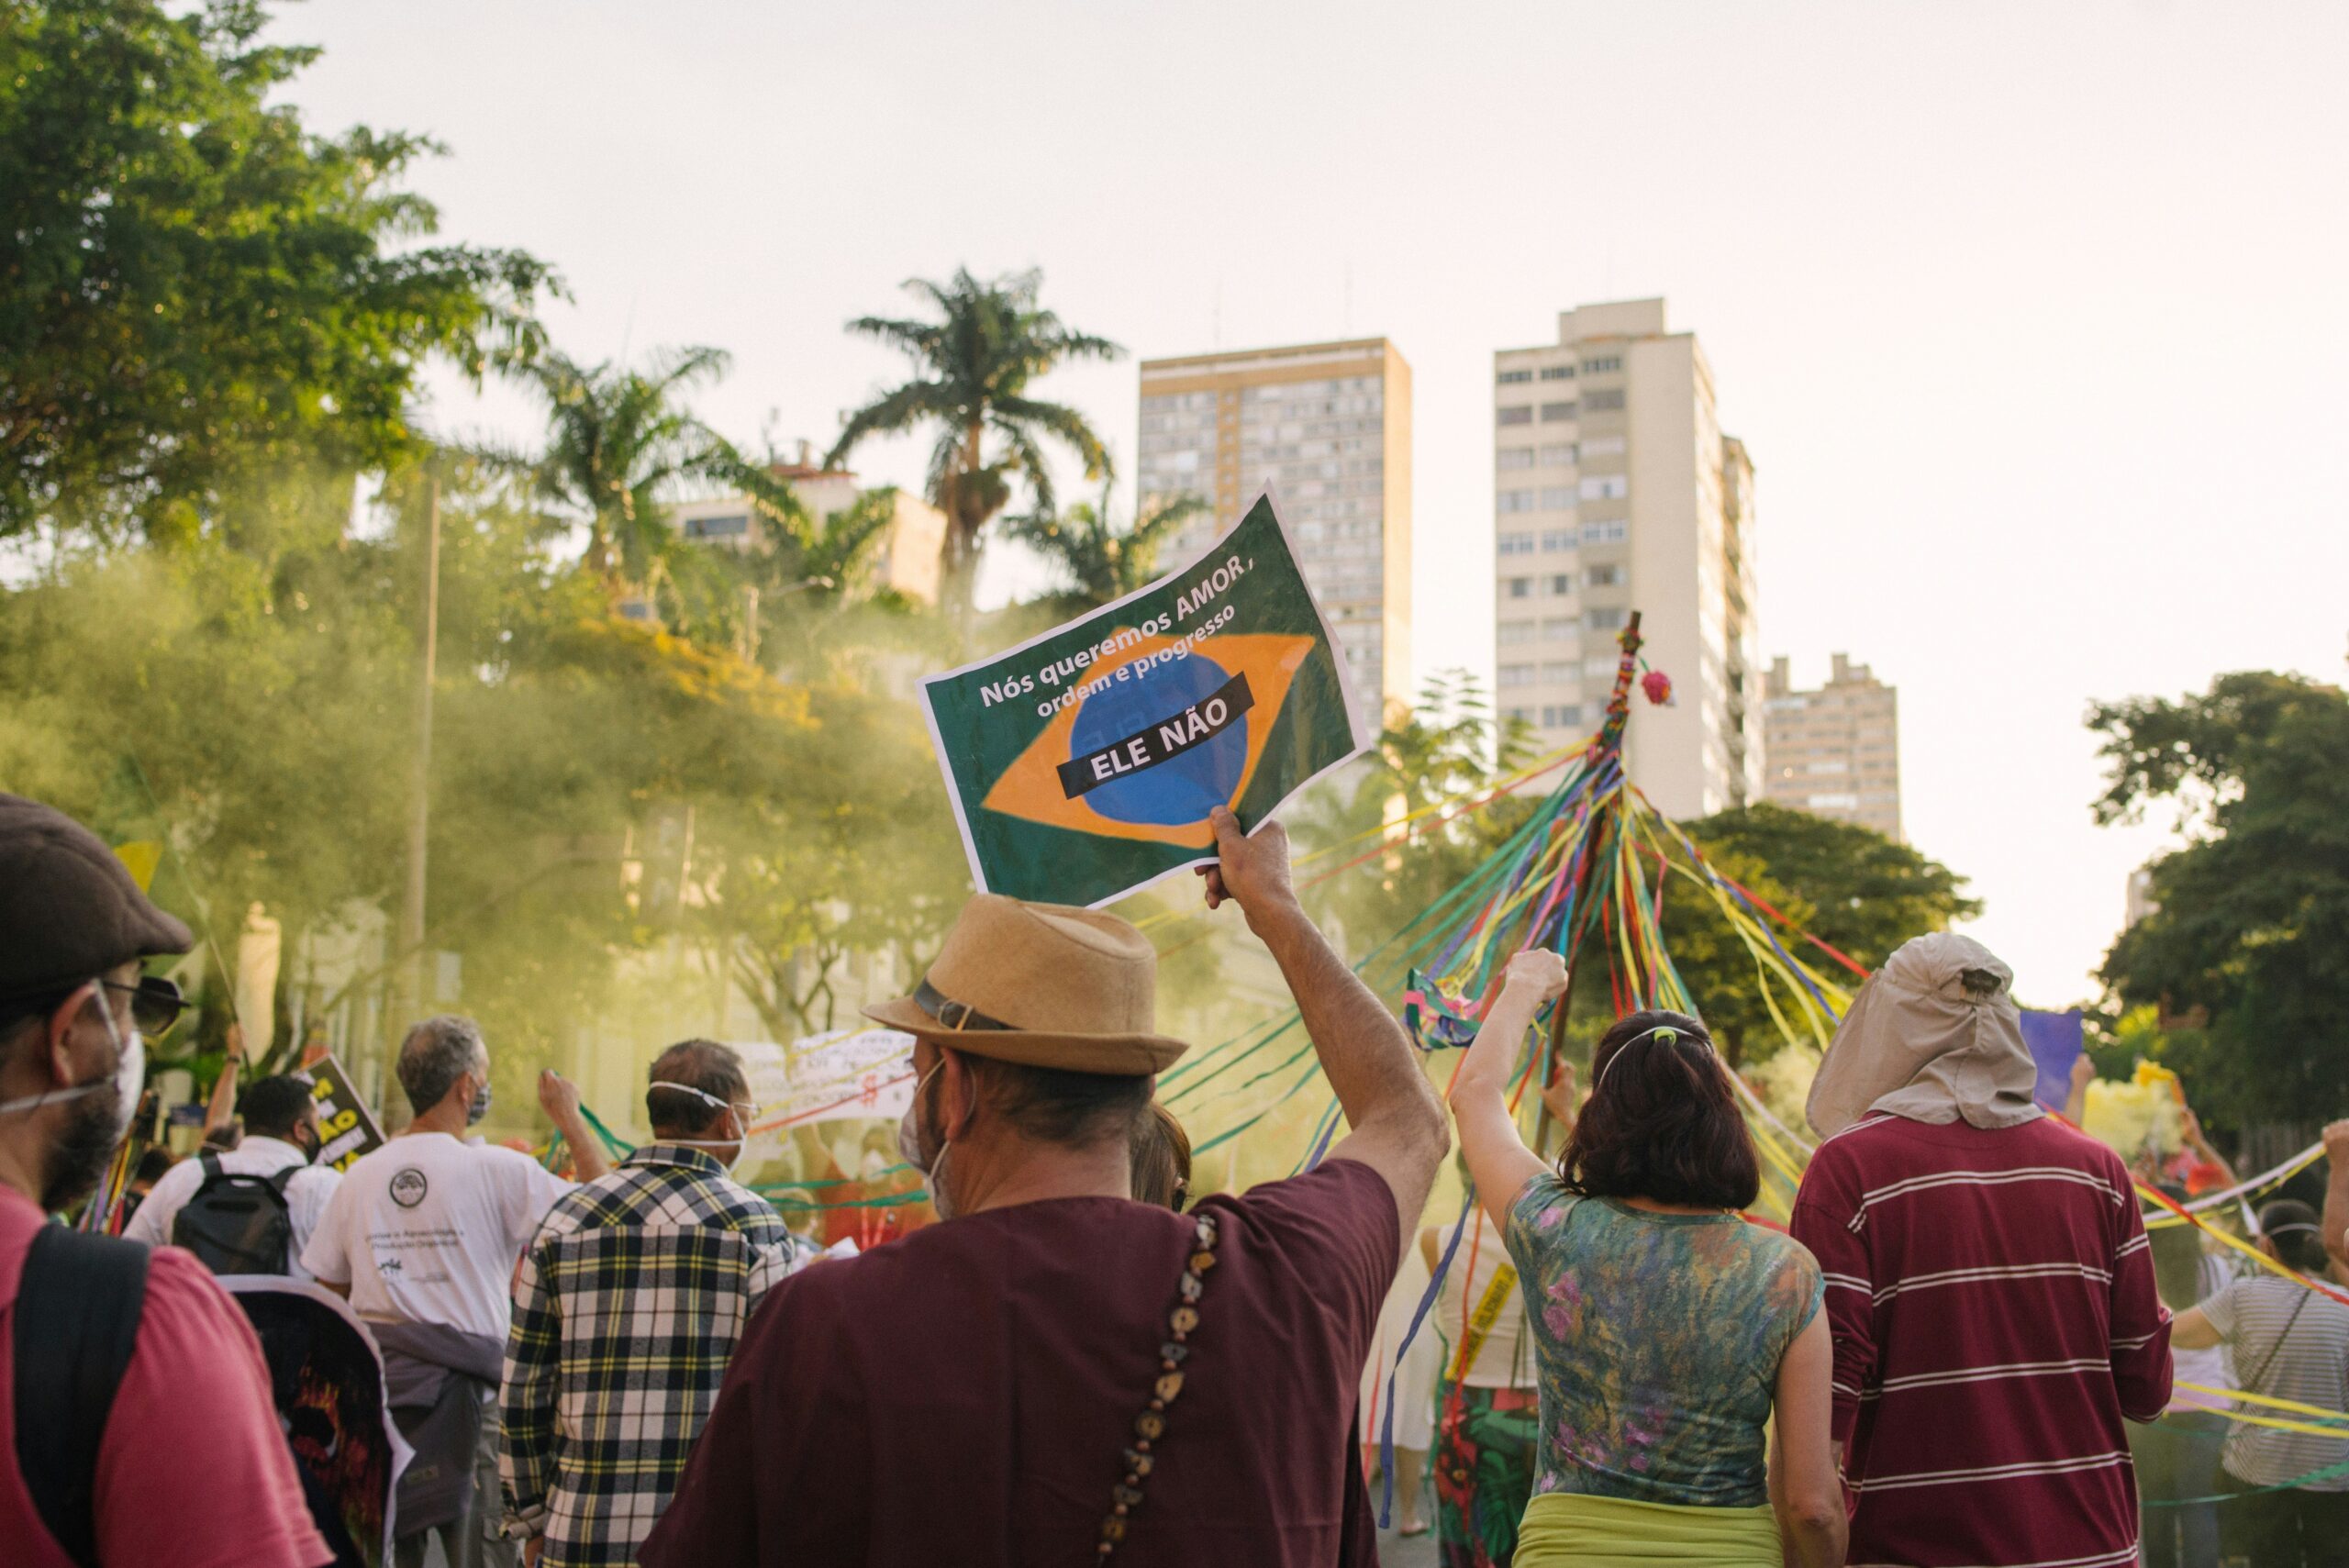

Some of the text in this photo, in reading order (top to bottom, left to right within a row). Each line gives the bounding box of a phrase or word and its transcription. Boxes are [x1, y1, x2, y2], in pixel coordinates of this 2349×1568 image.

[980, 555, 1253, 708] Nós queremos AMOR,
[1037, 605, 1235, 717] ordem e progresso
[1090, 697, 1228, 781] ELE NÃO
